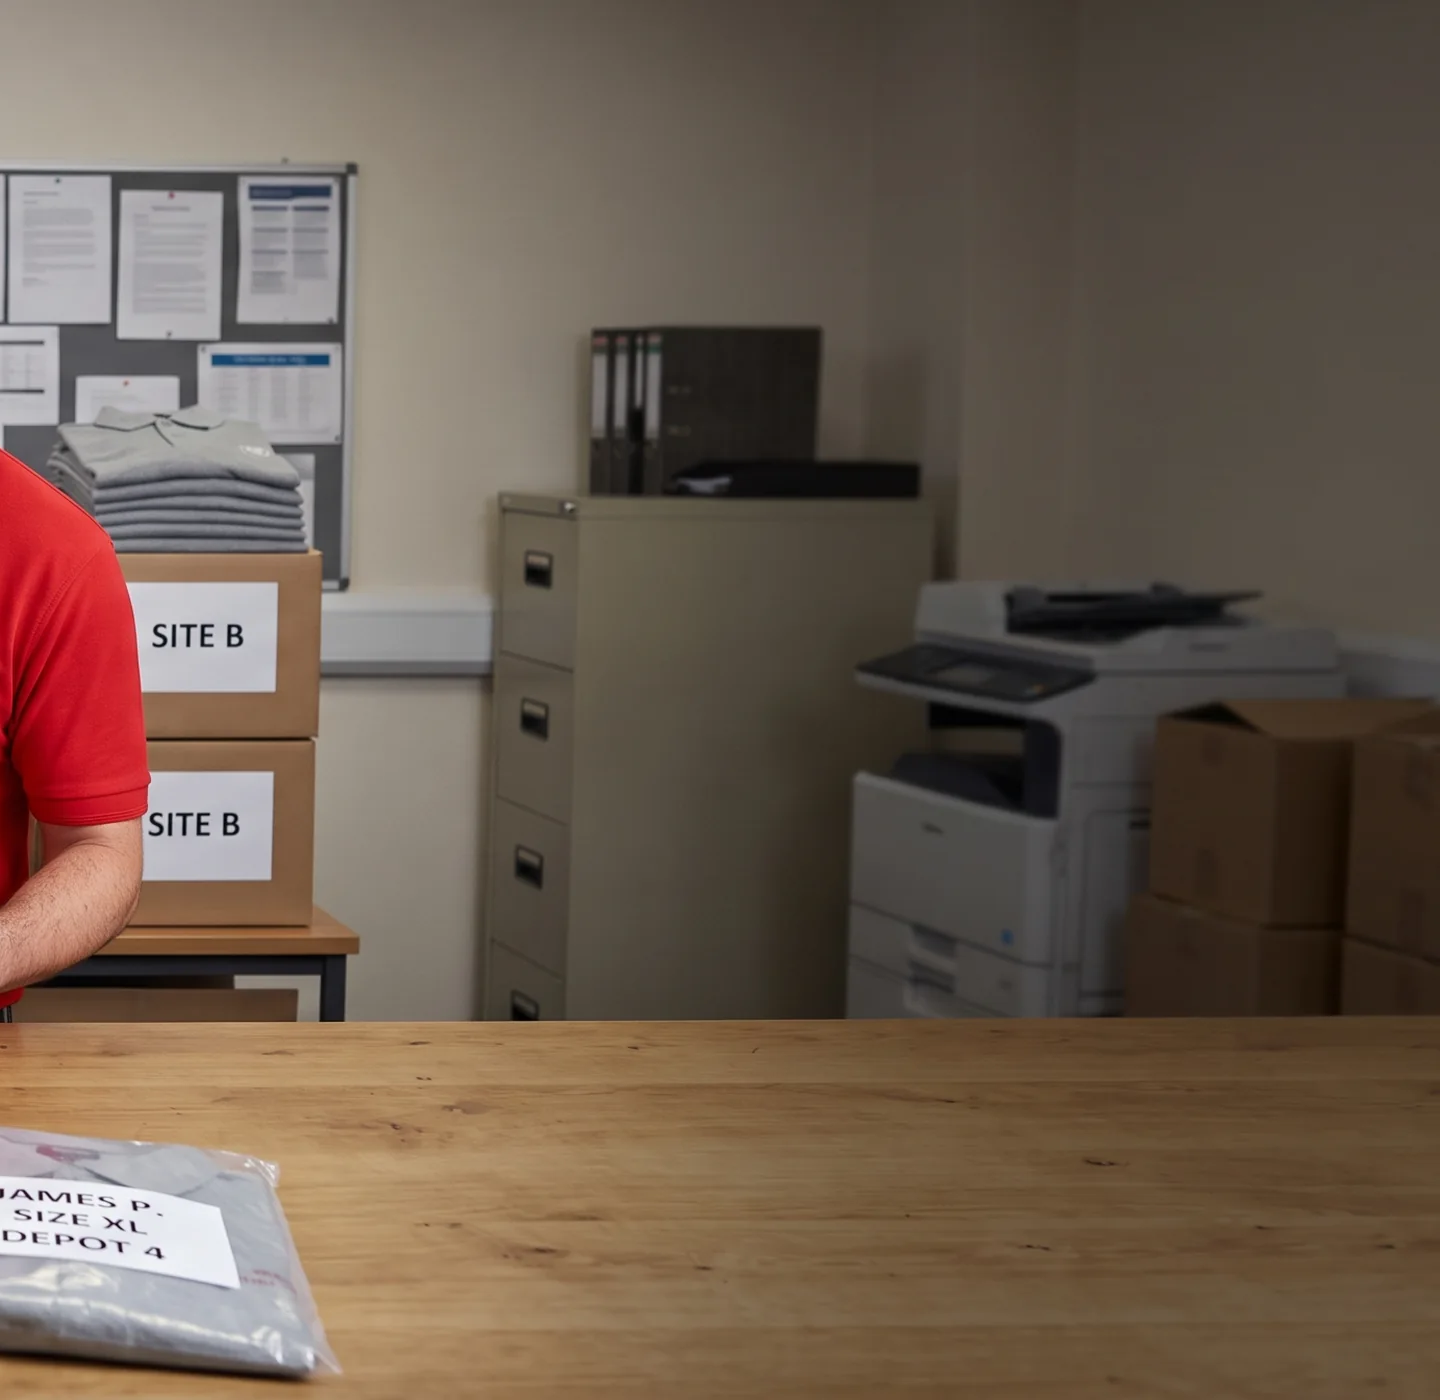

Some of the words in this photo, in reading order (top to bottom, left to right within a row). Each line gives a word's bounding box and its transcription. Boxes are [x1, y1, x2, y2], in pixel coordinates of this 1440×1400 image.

[152, 623, 215, 648] SITE
[226, 623, 244, 648] B
[148, 812, 211, 837] SITE
[222, 812, 240, 837] B
[131, 1200, 164, 1217] P.
[13, 1208, 90, 1227] SIZE
[103, 1216, 149, 1235] XL
[1, 1228, 133, 1251] DEPOT
[142, 1244, 166, 1260] 4
